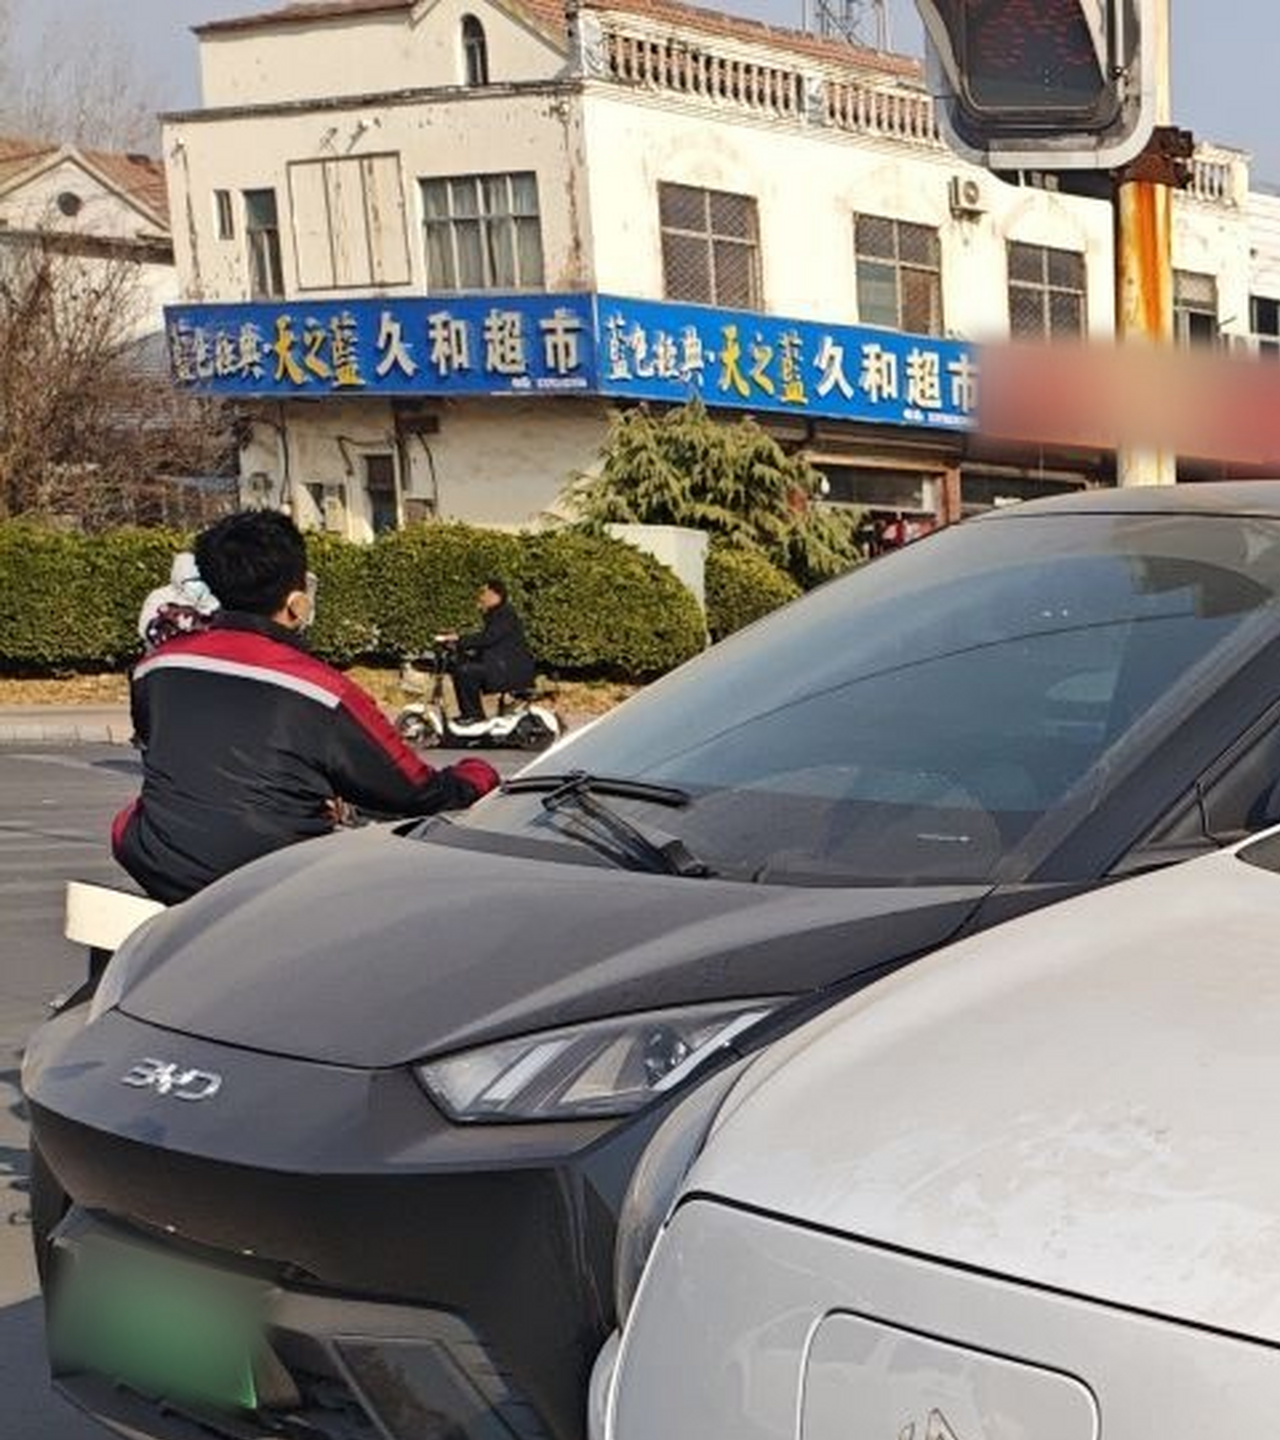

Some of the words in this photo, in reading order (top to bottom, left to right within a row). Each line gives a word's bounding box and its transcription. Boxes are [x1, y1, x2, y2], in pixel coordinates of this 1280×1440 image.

[376, 308, 581, 377] 久和超市
[813, 335, 979, 413] 久和超市
